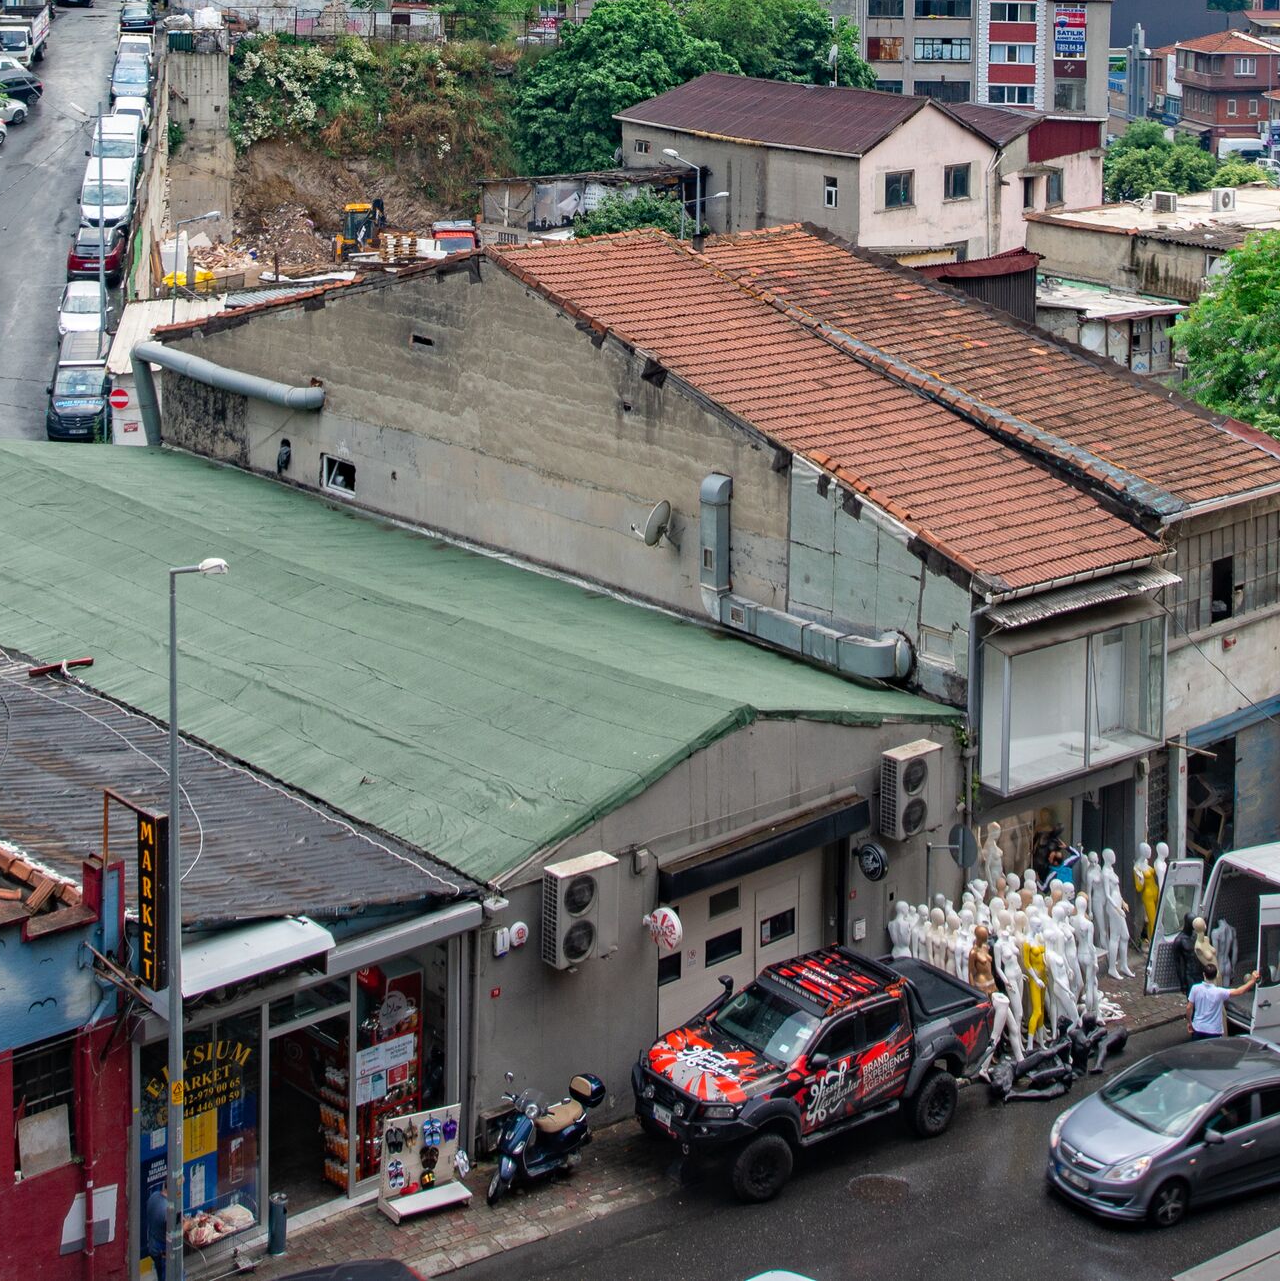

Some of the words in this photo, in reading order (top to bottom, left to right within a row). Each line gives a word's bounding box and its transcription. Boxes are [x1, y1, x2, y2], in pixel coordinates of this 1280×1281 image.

[140, 821, 154, 980] MARKET
[183, 1063, 231, 1093] ARKET
[863, 1052, 890, 1077] BRAND
[863, 1048, 910, 1086] EXPERIENCE
[216, 1081, 227, 1092] 00
[229, 1077, 240, 1089] 65
[863, 1067, 896, 1095] AGENCY
[196, 1101, 213, 1113] 446
[215, 1095, 227, 1107] 00
[229, 1089, 240, 1102] 59
